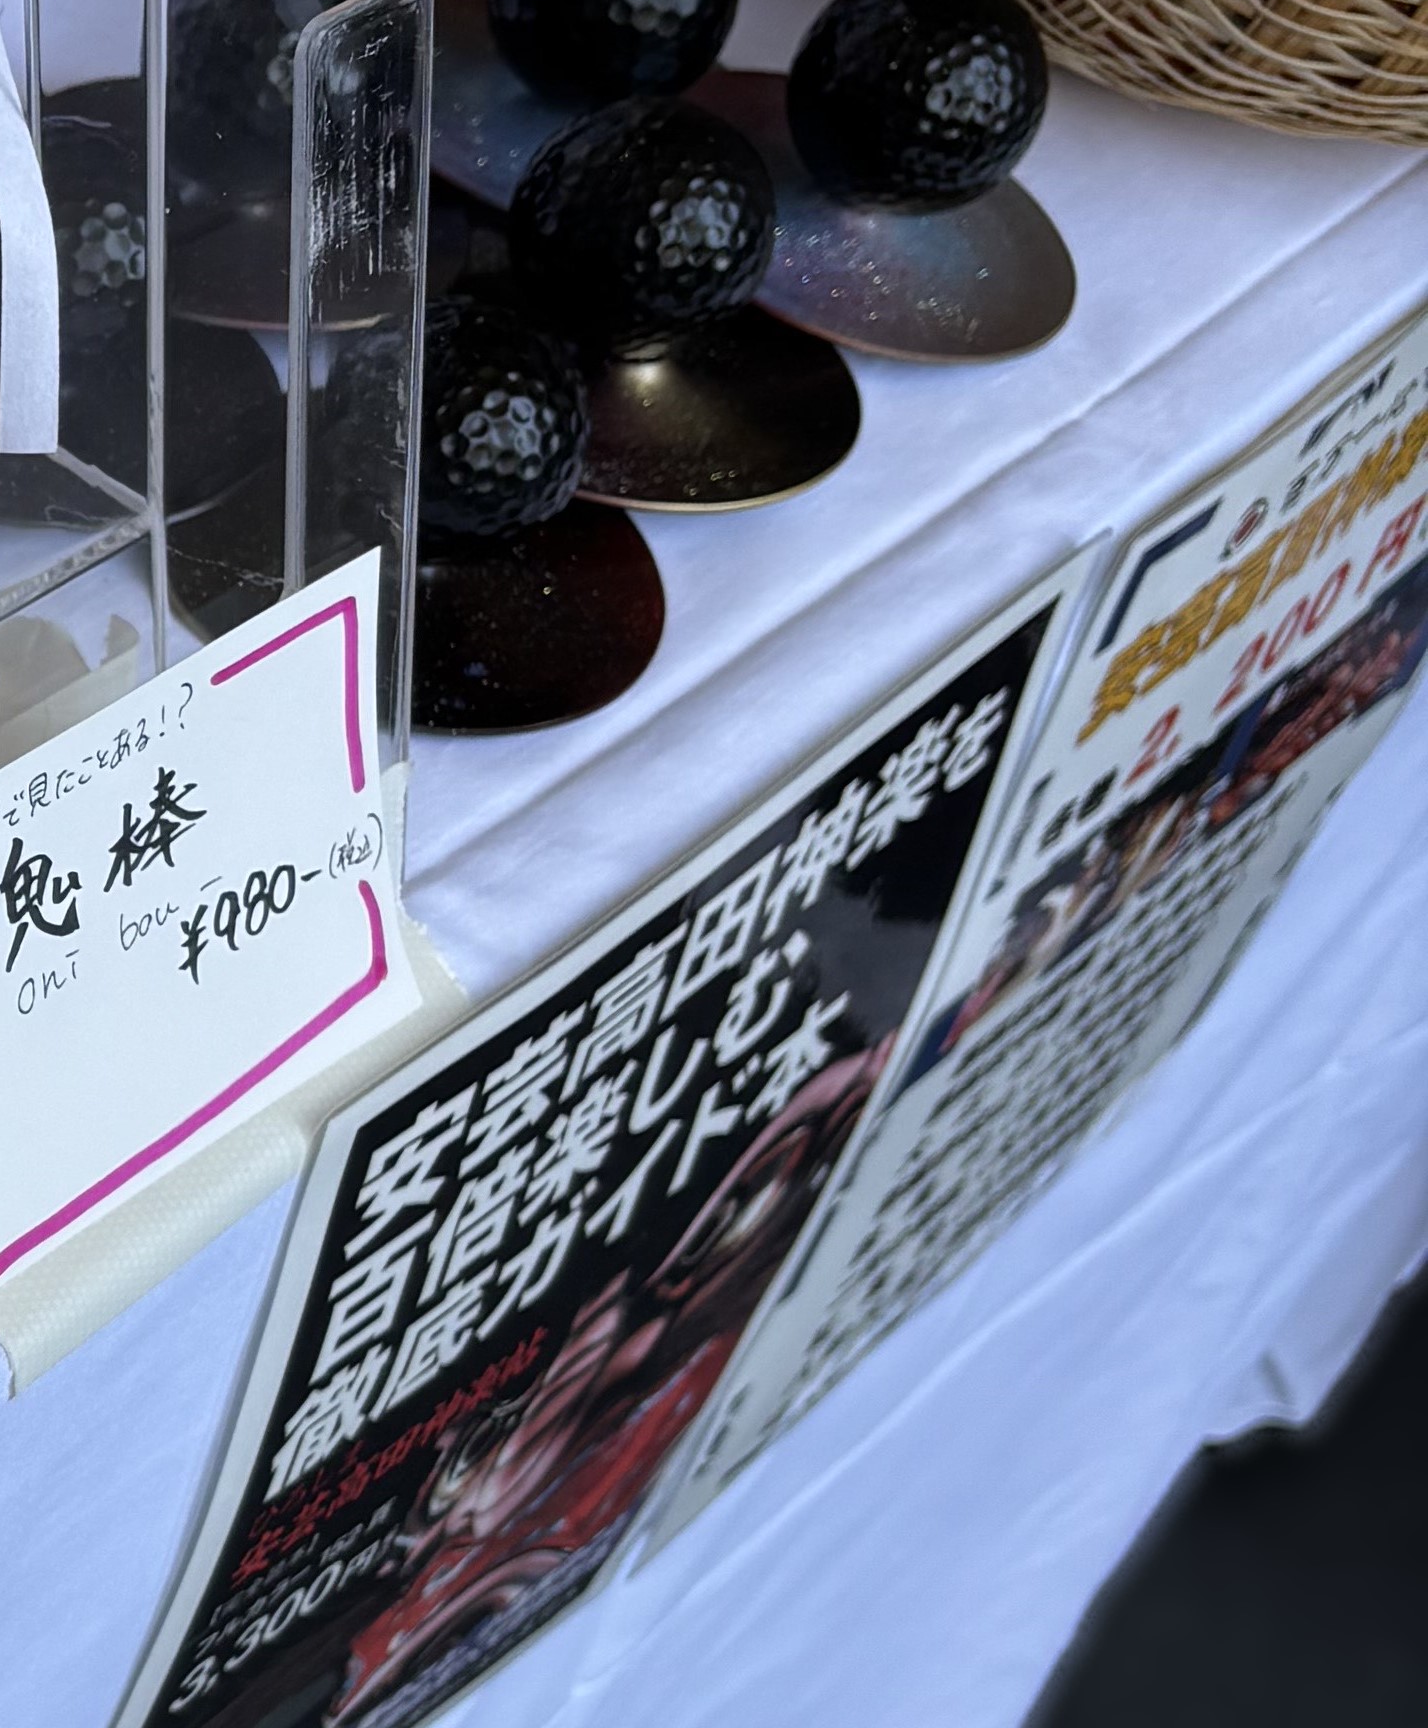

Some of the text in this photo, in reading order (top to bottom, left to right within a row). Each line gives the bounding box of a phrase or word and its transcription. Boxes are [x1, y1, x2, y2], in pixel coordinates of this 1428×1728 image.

[308, 929, 814, 1388] 百倍楽しむ
[345, 688, 1012, 1262] 安芸高田神楽を
[262, 989, 854, 1503] 徹底ガイド本
